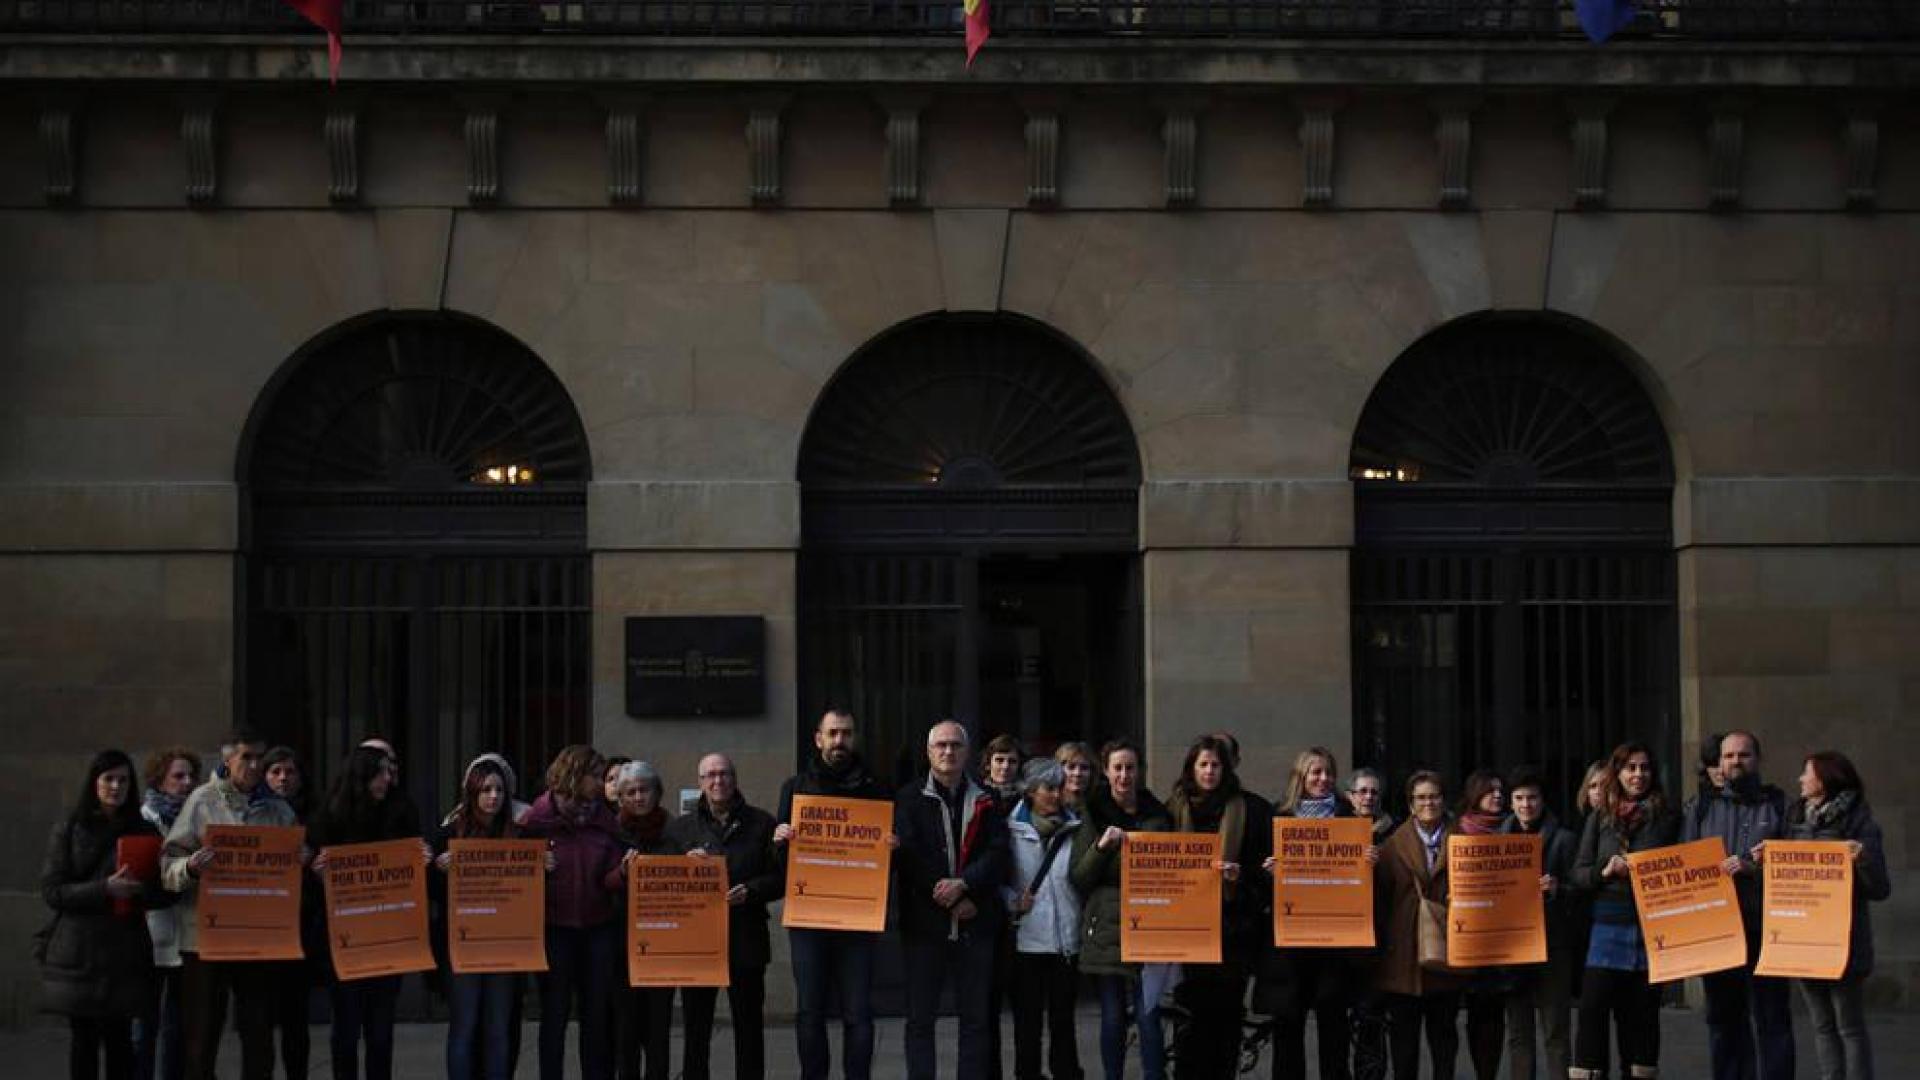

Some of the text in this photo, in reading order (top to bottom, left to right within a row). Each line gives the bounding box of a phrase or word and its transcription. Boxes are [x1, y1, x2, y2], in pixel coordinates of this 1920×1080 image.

[800, 806, 848, 822] GRACIAS
[798, 822, 882, 841] POR TU APOYO
[1282, 827, 1329, 841] GRACIAS
[212, 836, 260, 847] GRACIAS
[1130, 841, 1212, 856] ESKERRIK ASKO
[457, 849, 537, 863] ESKERRIK ASKO
[1282, 843, 1362, 858] POR TU APOYO
[1453, 842, 1534, 858] ESKERRIK ASKO
[238, 851, 252, 865] TU
[255, 851, 292, 867] APOYO
[330, 853, 379, 869] GRACIAS
[1129, 856, 1212, 870] LAGUNTZEAGATIK
[1453, 857, 1533, 871] LAGUNTZEAGATIK
[1636, 854, 1683, 875] GRACIAS
[1769, 851, 1846, 865] ESKERRIK ASKO
[331, 865, 415, 885] POR TU APOYO
[457, 865, 536, 878] LAGUNTZEAGATIK
[637, 865, 720, 878] ESKERRIK ASKO
[1640, 864, 1721, 890] POR TU APOYO
[1769, 866, 1846, 881] LAGUNTZEAGATIK
[637, 881, 720, 893] LAGUNTZEAGATIK
